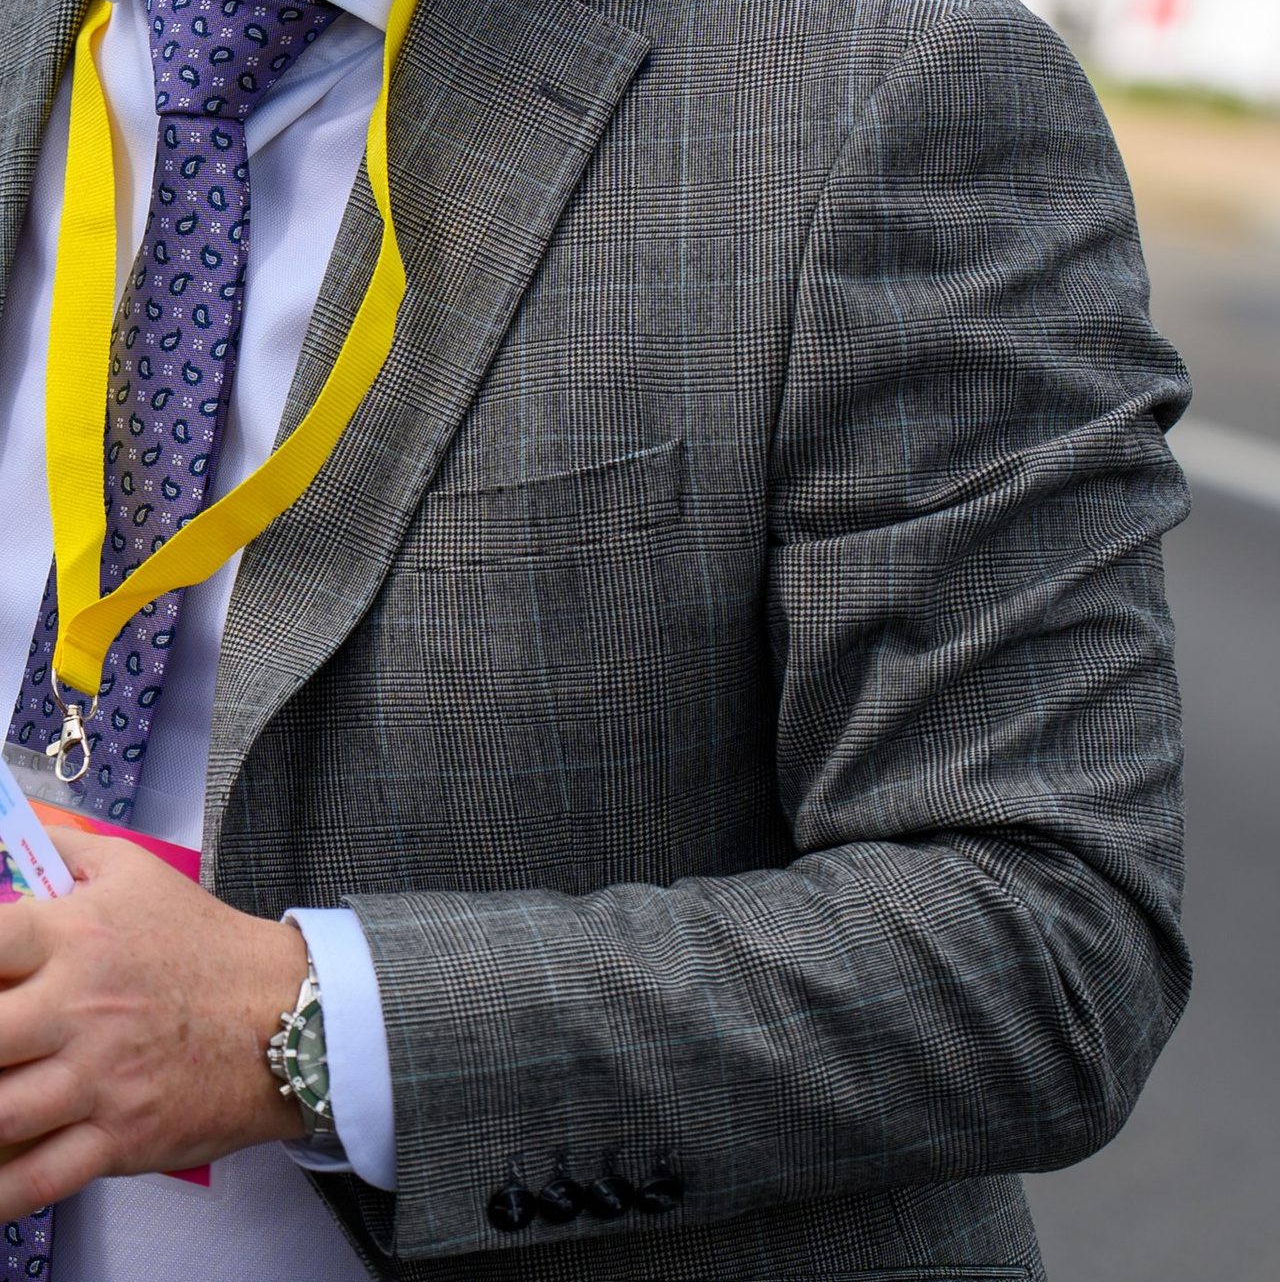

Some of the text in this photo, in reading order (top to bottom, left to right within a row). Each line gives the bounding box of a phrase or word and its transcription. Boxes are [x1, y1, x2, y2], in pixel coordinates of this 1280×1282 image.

[21, 837, 37, 865] Bank
[293, 1015, 307, 1031] 30
[291, 1075, 307, 1091] 20
